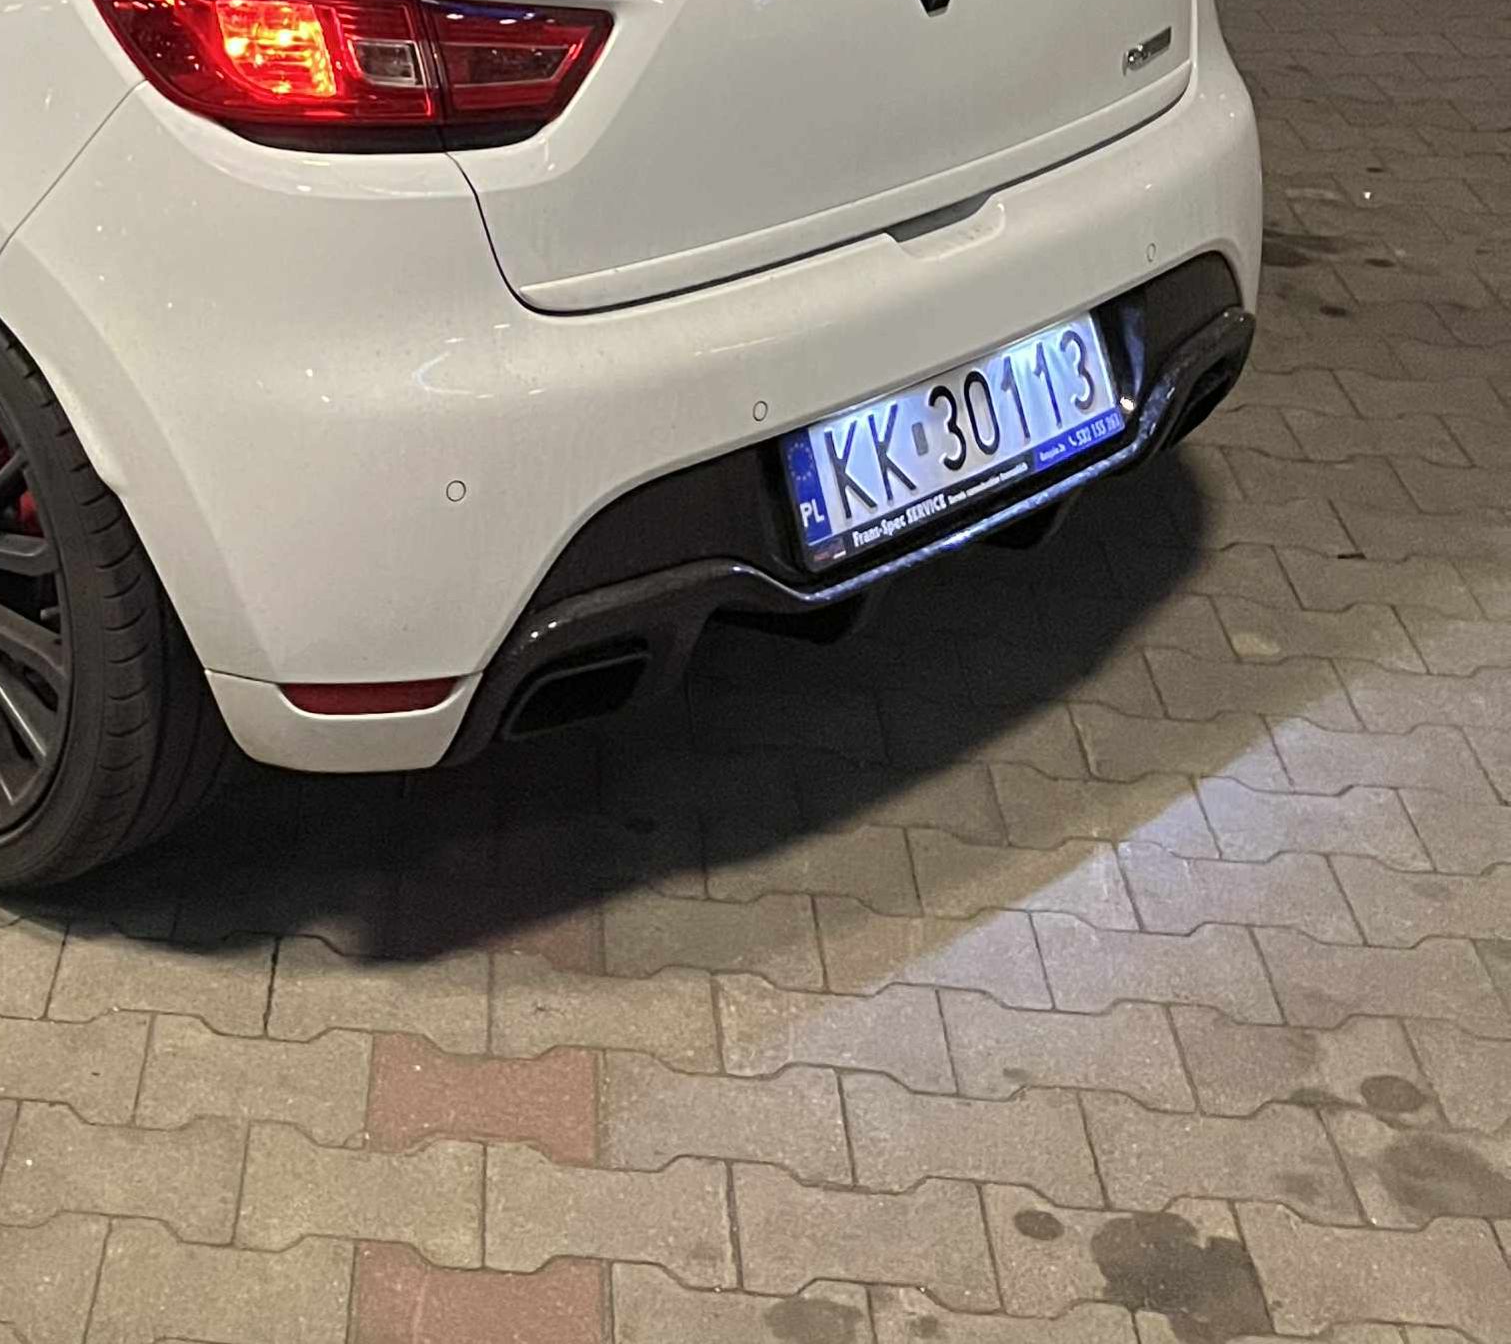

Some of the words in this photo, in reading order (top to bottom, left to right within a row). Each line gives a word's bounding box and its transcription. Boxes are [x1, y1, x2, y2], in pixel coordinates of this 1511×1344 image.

[825, 404, 917, 519] KK
[928, 329, 1096, 472] 30113
[800, 498, 825, 527] PL
[906, 494, 947, 525] SERVICE
